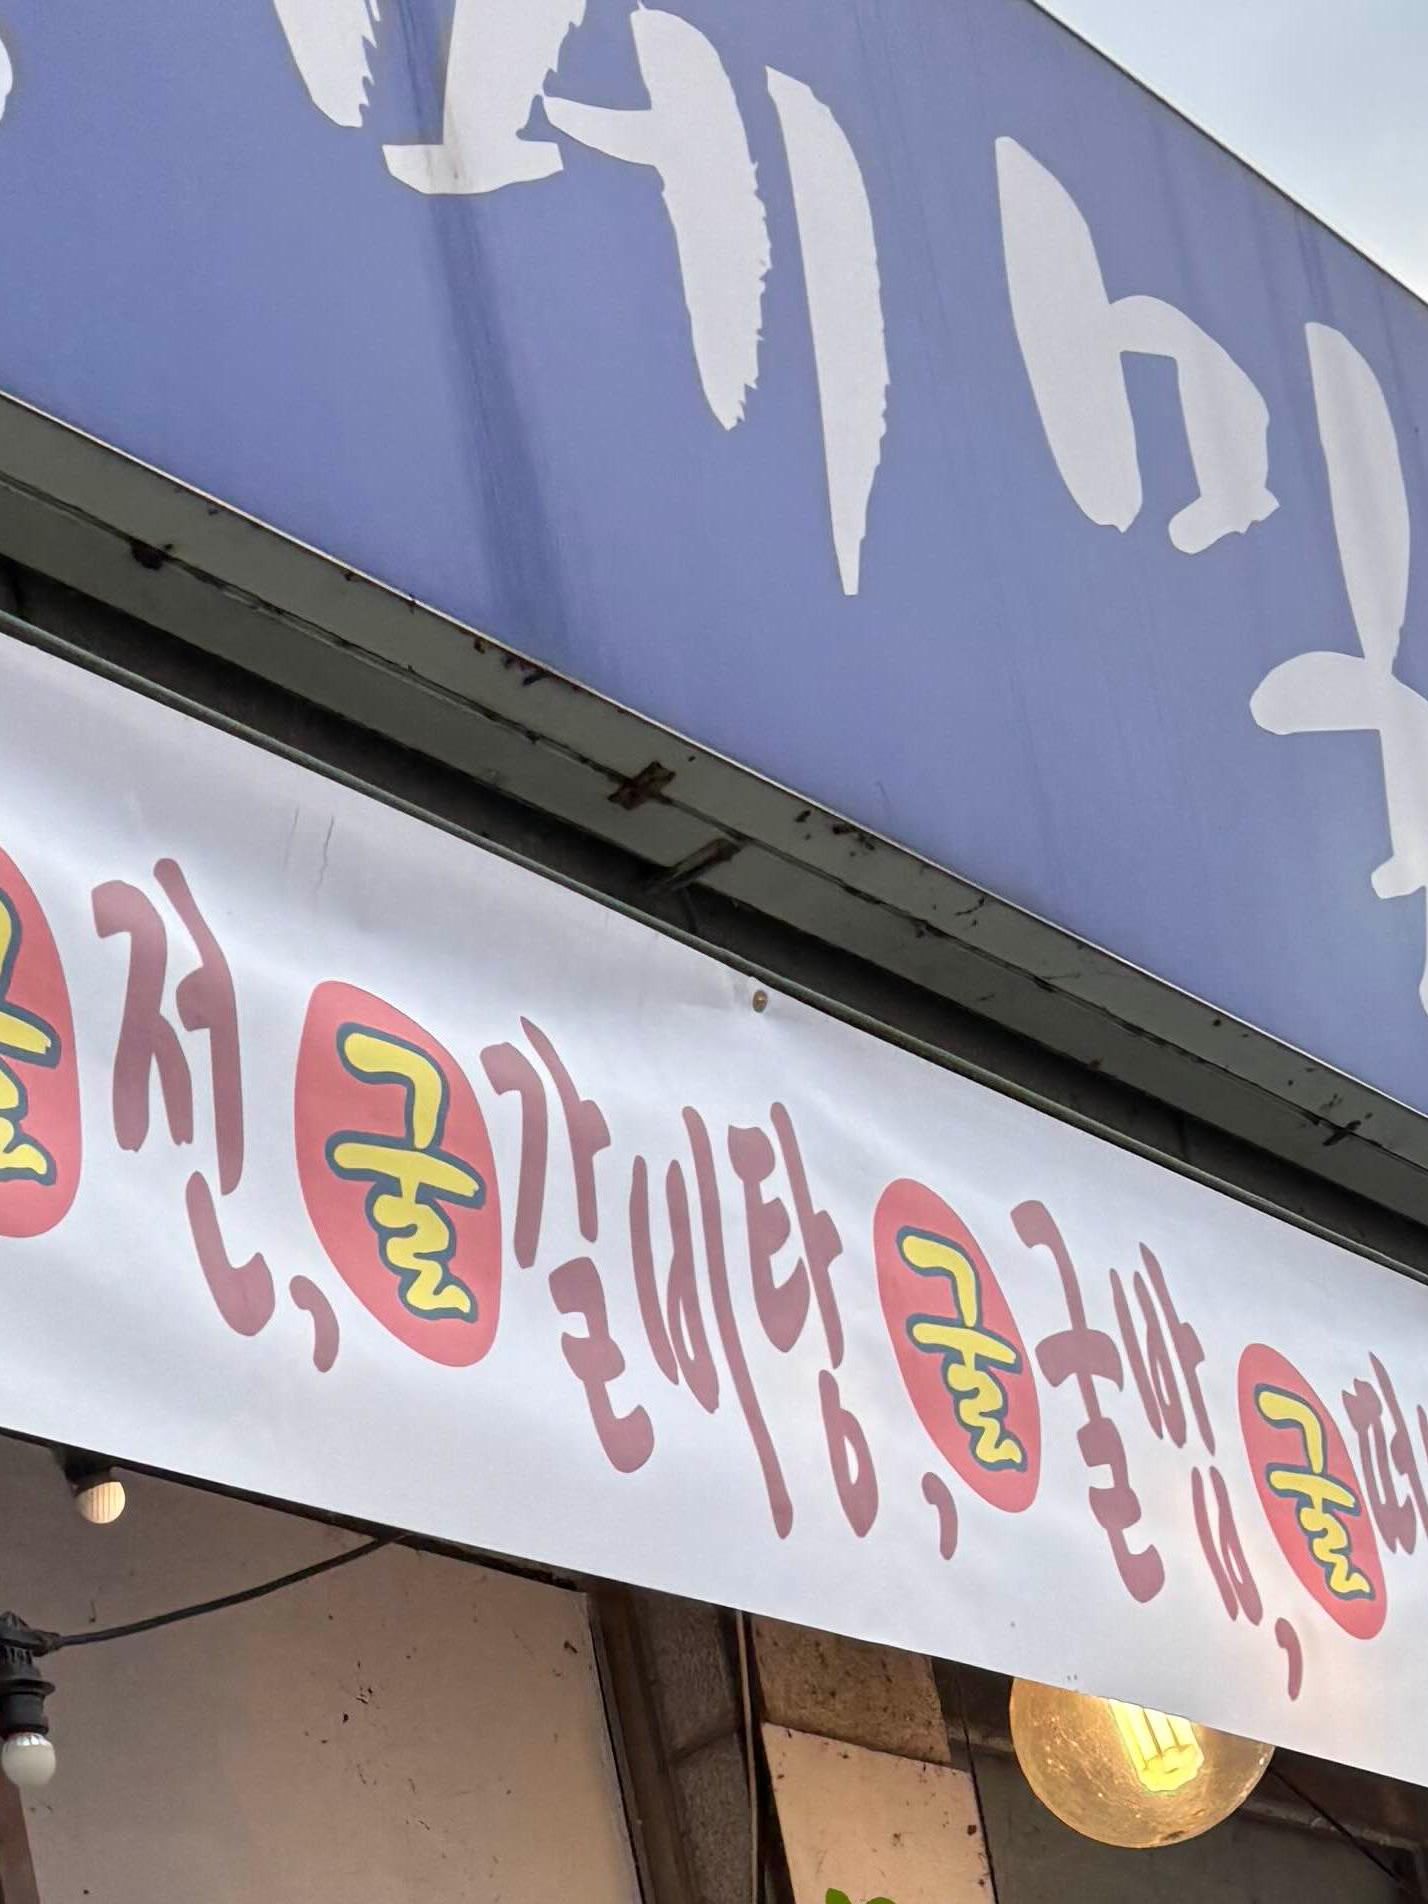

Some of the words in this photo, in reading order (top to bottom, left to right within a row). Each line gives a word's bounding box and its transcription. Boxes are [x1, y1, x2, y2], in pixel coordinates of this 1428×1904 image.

[324, 1021, 487, 1324] 굴
[896, 1226, 1028, 1473] 굴
[1255, 1383, 1376, 1602] 굴
